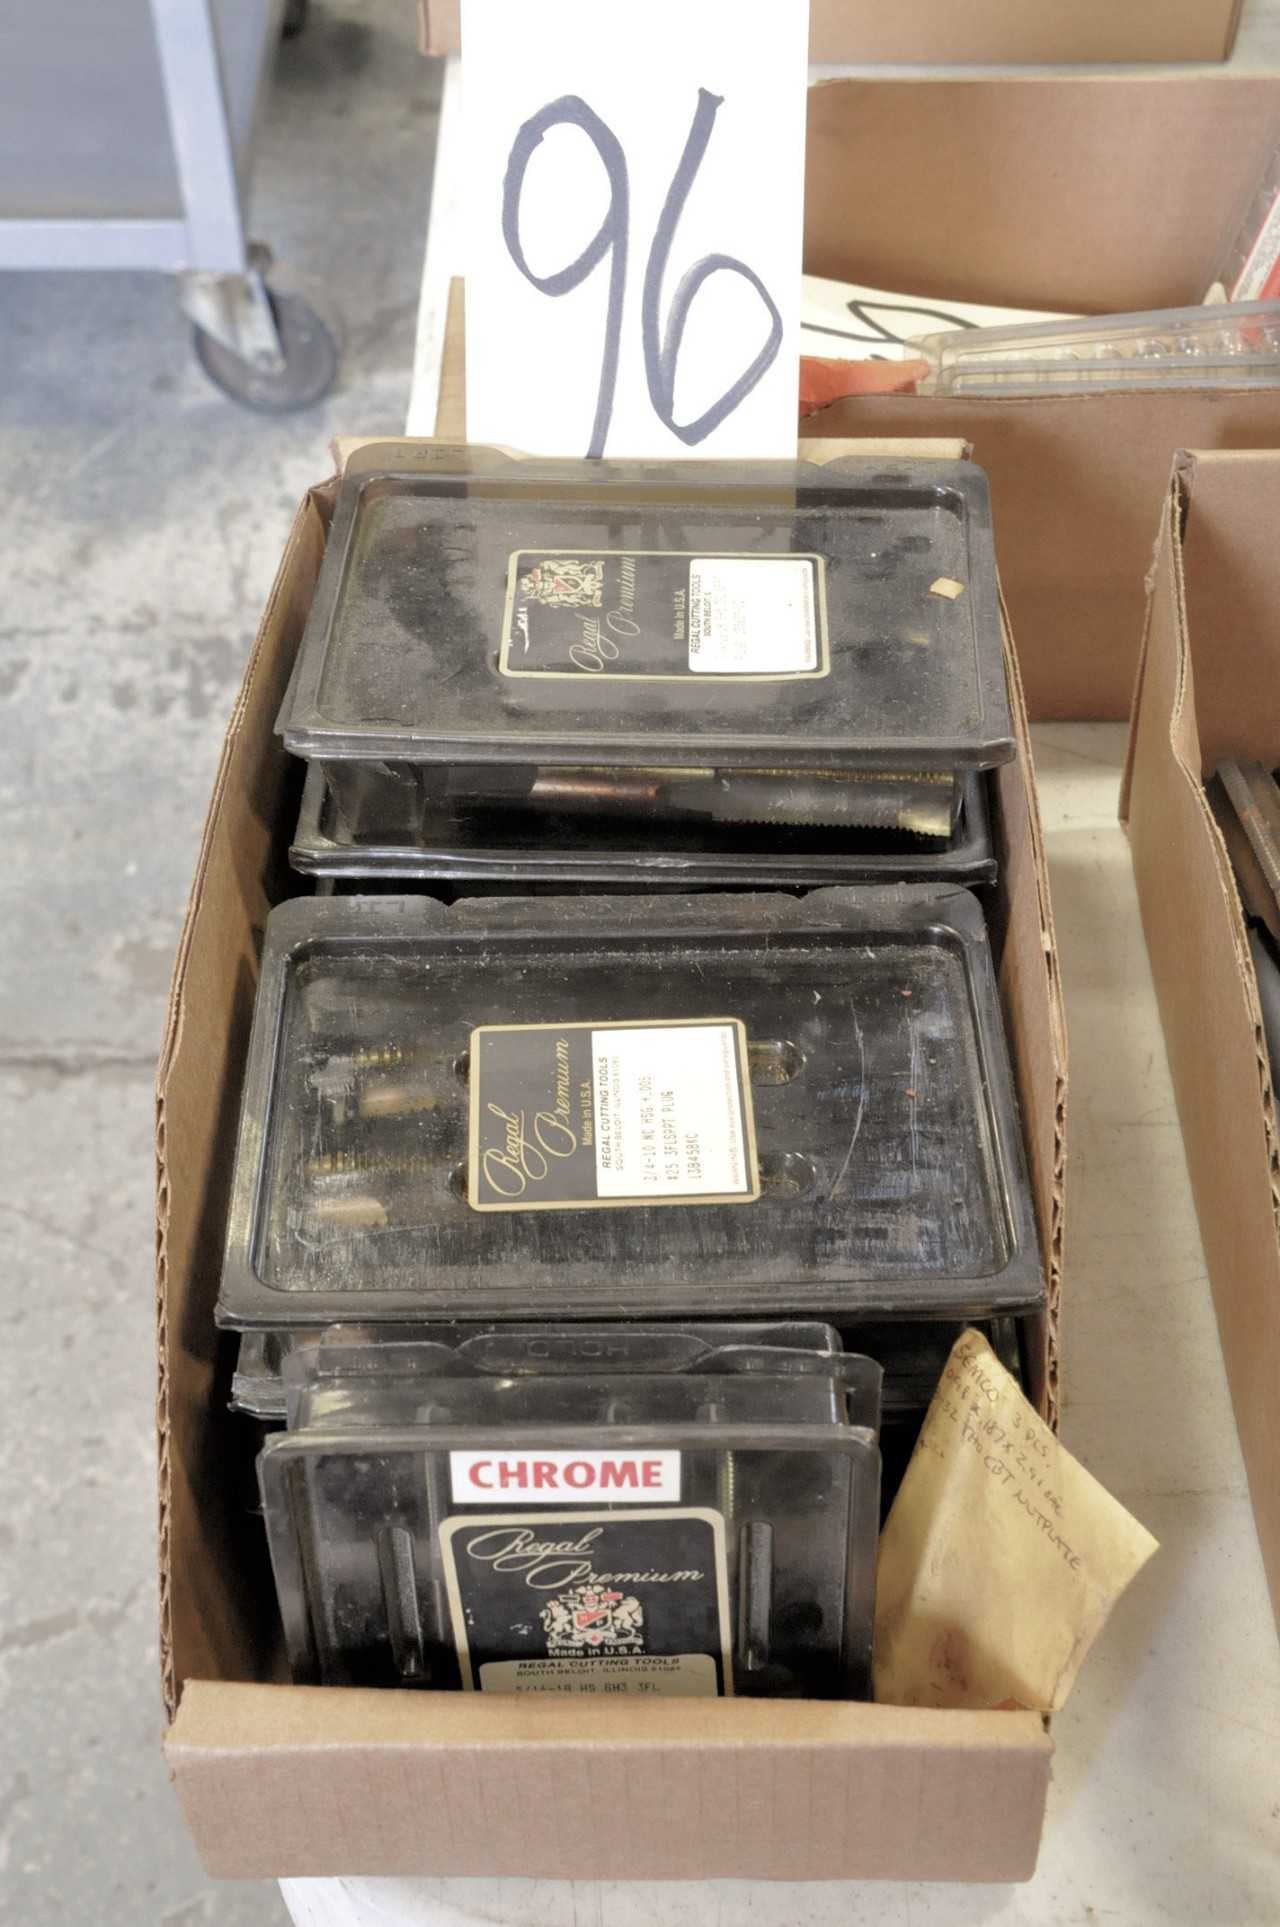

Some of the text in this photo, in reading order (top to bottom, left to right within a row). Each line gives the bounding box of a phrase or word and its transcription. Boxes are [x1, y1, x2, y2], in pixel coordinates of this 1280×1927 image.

[501, 86, 784, 461] 96
[606, 557, 641, 636] Premium
[690, 573, 702, 655] REGAL CUTTING TOOLS
[569, 612, 620, 673] Regal
[673, 620, 686, 640] Made
[534, 1037, 577, 1158] Premium
[581, 1109, 592, 1119] in
[598, 1057, 612, 1169] REGAL CUTTING TOOLS
[483, 1103, 548, 1197] Regal
[581, 1120, 593, 1146] Made
[468, 1460, 663, 1489] CHROME
[467, 1527, 603, 1572] Regal
[526, 1560, 704, 1590] Premium
[518, 1657, 681, 1670] REGAL CUTTING TOOLS
[548, 1647, 646, 1657] Made in U.S.A.
[516, 1669, 556, 1677] SOUTH
